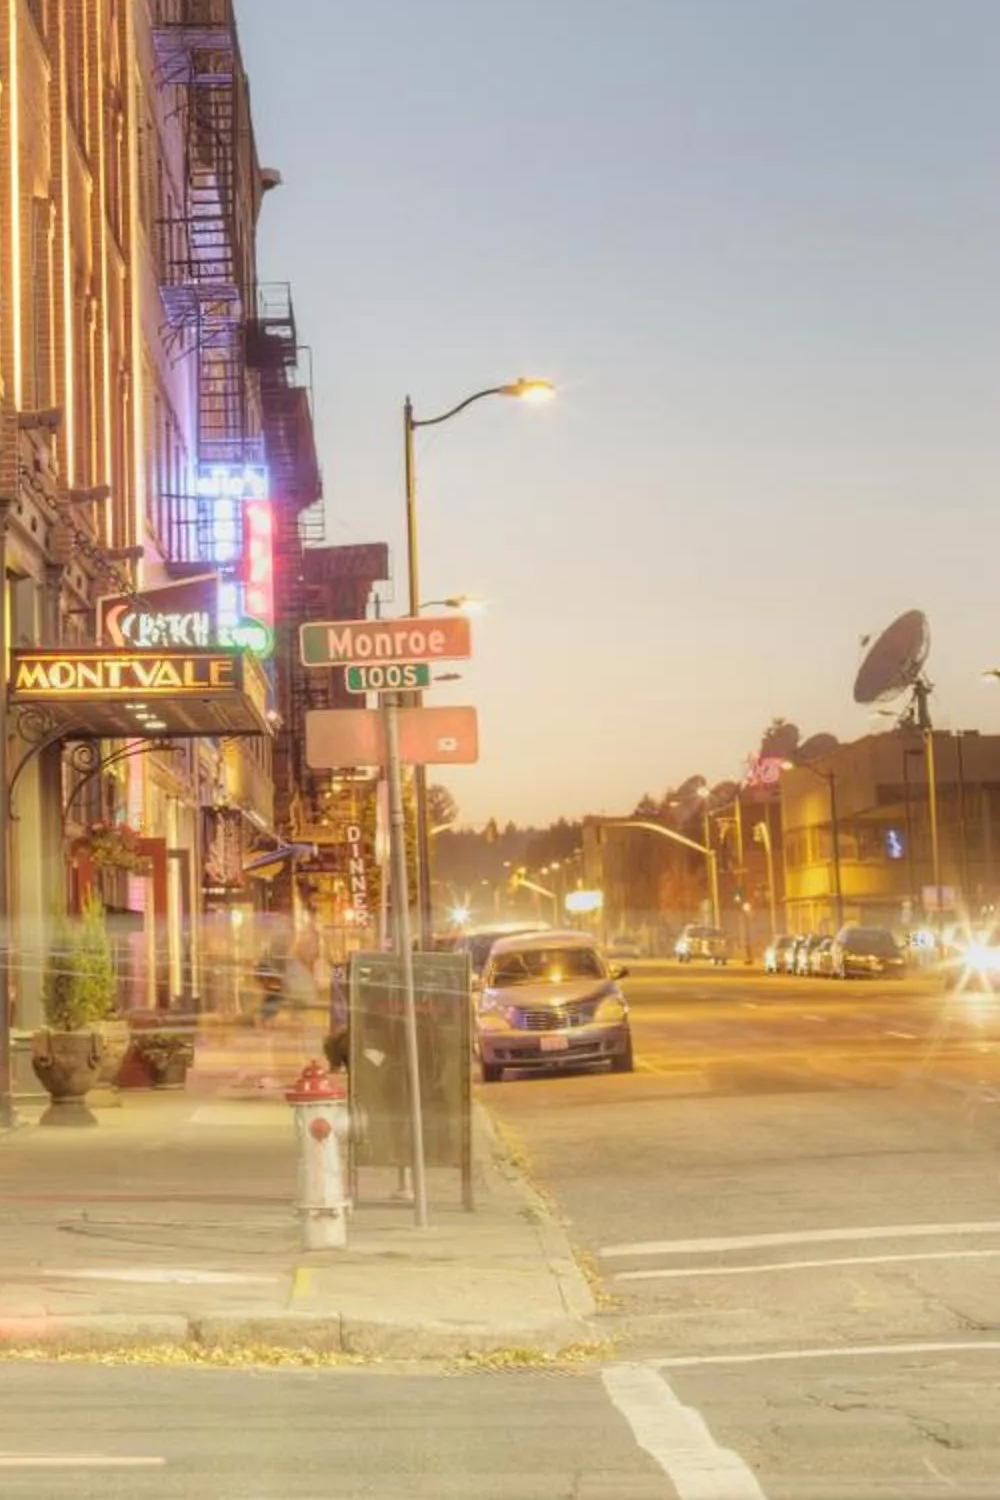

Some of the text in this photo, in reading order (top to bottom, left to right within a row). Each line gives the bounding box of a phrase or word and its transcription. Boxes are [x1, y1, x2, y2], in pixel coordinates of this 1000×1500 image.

[327, 628, 446, 660] Monroe
[16, 659, 234, 688] MONTVALE
[358, 665, 418, 688] 100S
[347, 825, 369, 928] DINNER
